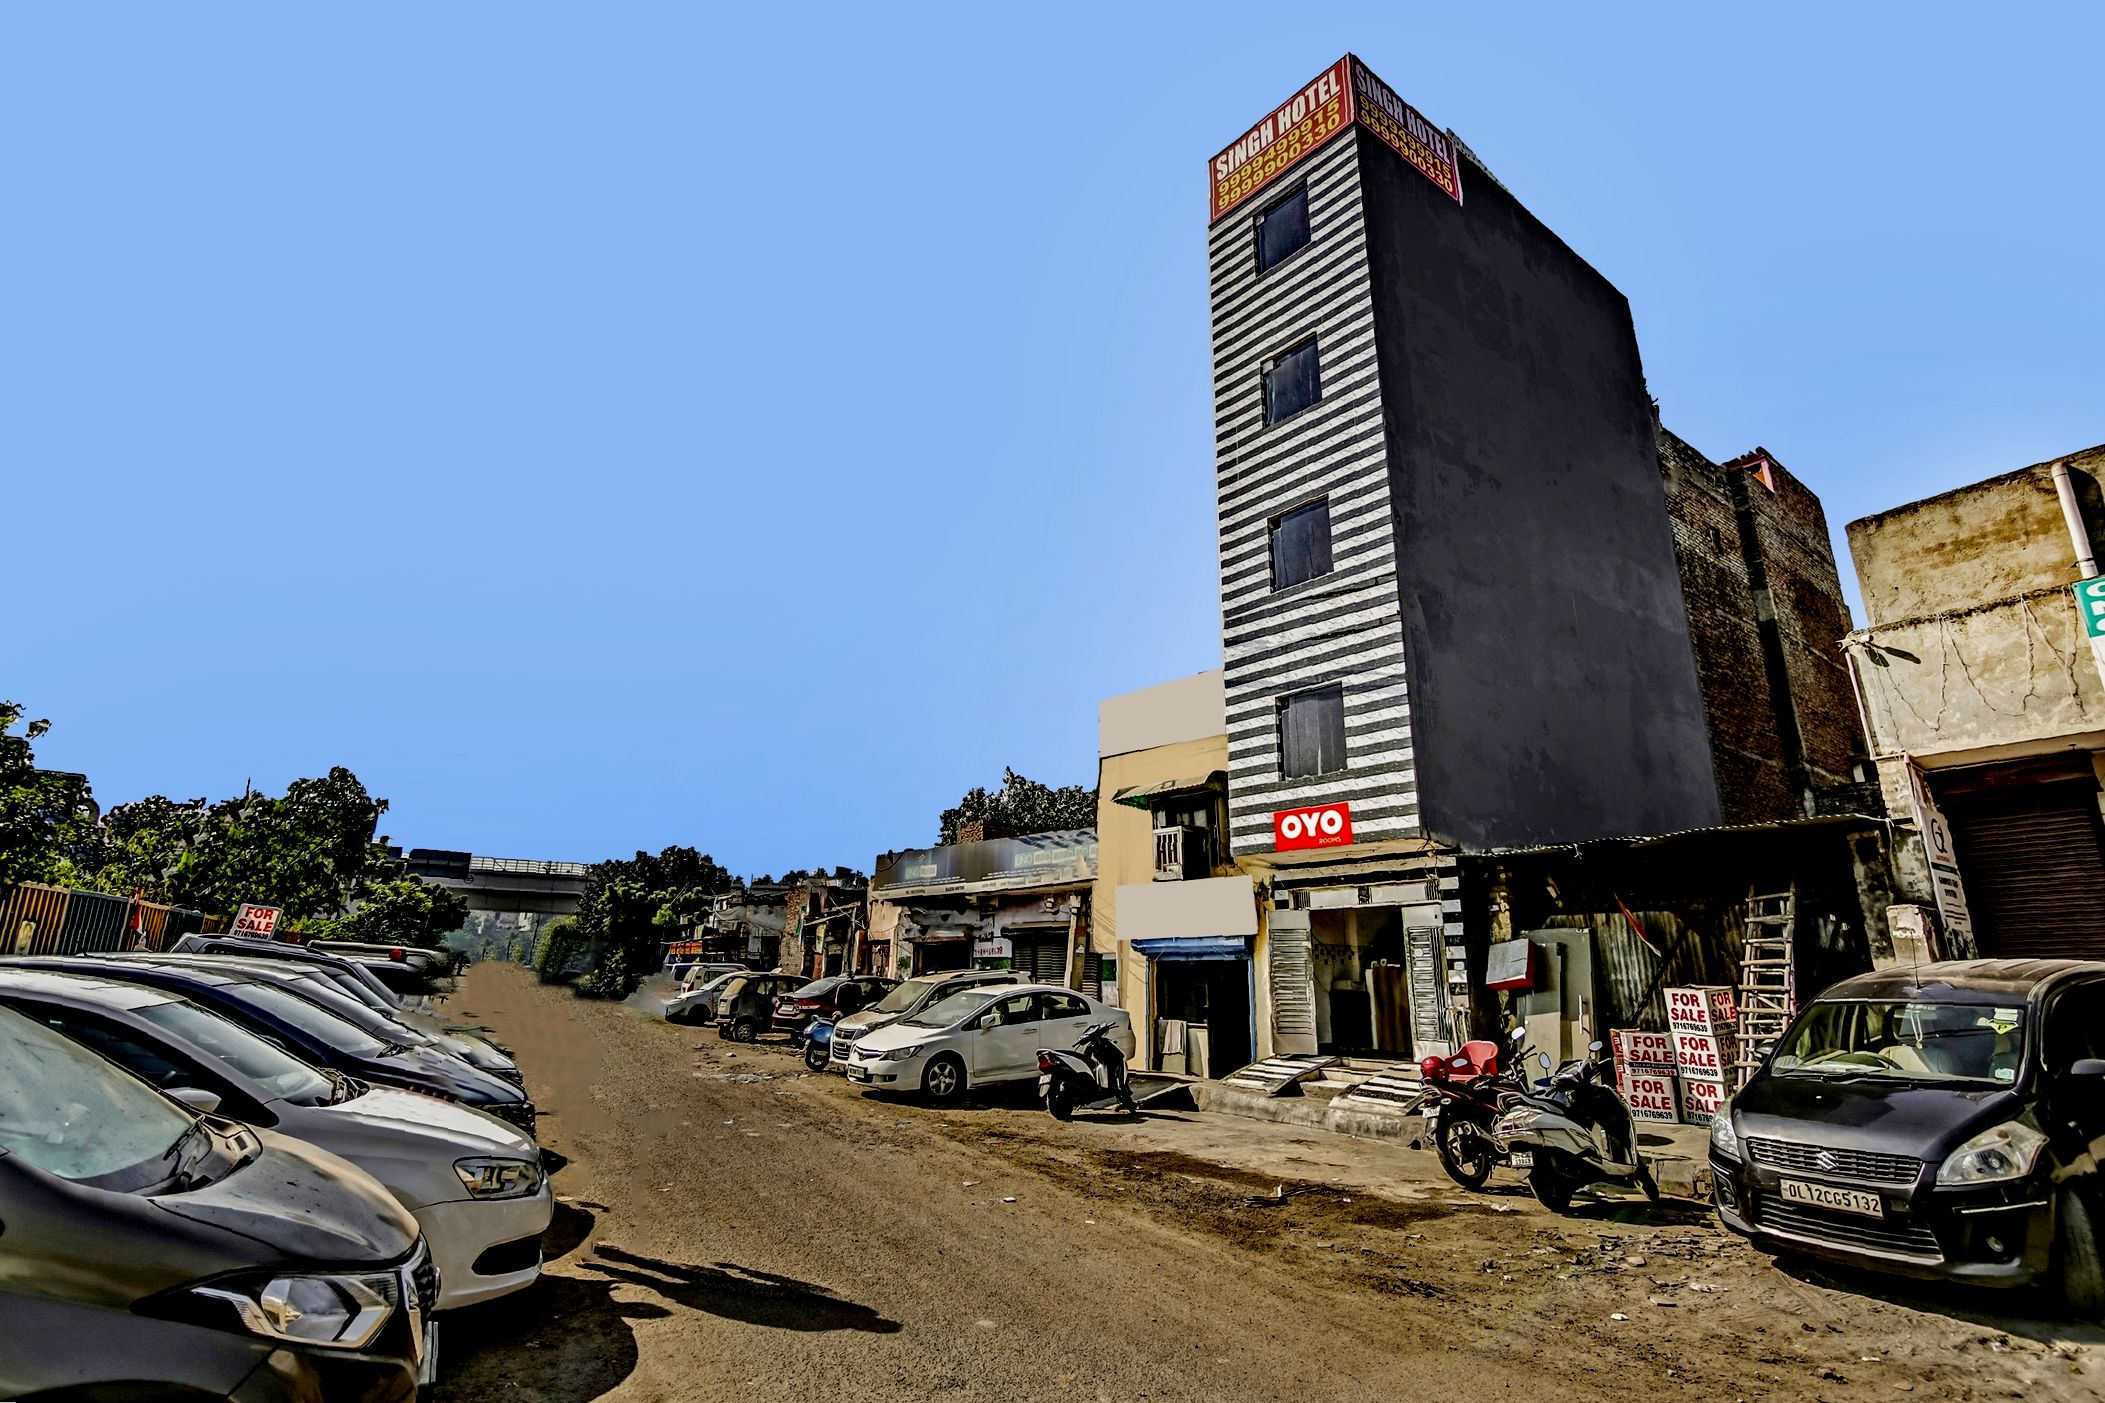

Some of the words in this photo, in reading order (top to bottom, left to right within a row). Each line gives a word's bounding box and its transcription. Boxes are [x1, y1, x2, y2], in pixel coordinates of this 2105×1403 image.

[1355, 64, 1404, 126] SINGH
[1406, 107, 1451, 165] HOTEL
[1216, 118, 1274, 181] SINGH
[1278, 69, 1341, 135] HOTEL
[1359, 95, 1452, 178] 9999499915
[1218, 97, 1340, 197] 9999499915
[1361, 109, 1454, 193] 9999900330
[1218, 113, 1341, 210] 9999900330
[1280, 809, 1343, 840] OYO
[1318, 837, 1341, 845] ROOMS
[245, 907, 273, 920] FOR
[237, 918, 273, 932] SALE
[1671, 993, 1701, 1008] FOR
[1710, 991, 1731, 1007] FOR
[1671, 1007, 1707, 1023] SALE
[1711, 1006, 1737, 1023] SALE
[1632, 1035, 1668, 1050] FOR
[1679, 1036, 1711, 1052] FOR
[1719, 1035, 1738, 1051] FOR
[1629, 1049, 1674, 1065] SALE
[1678, 1051, 1717, 1068] SALE
[1631, 1079, 1665, 1095] FOR
[1686, 1081, 1718, 1099] FOR
[1629, 1094, 1672, 1111] SALE
[1631, 1109, 1673, 1120] 9716769639
[1788, 1182, 1882, 1213] DL12CG5132
